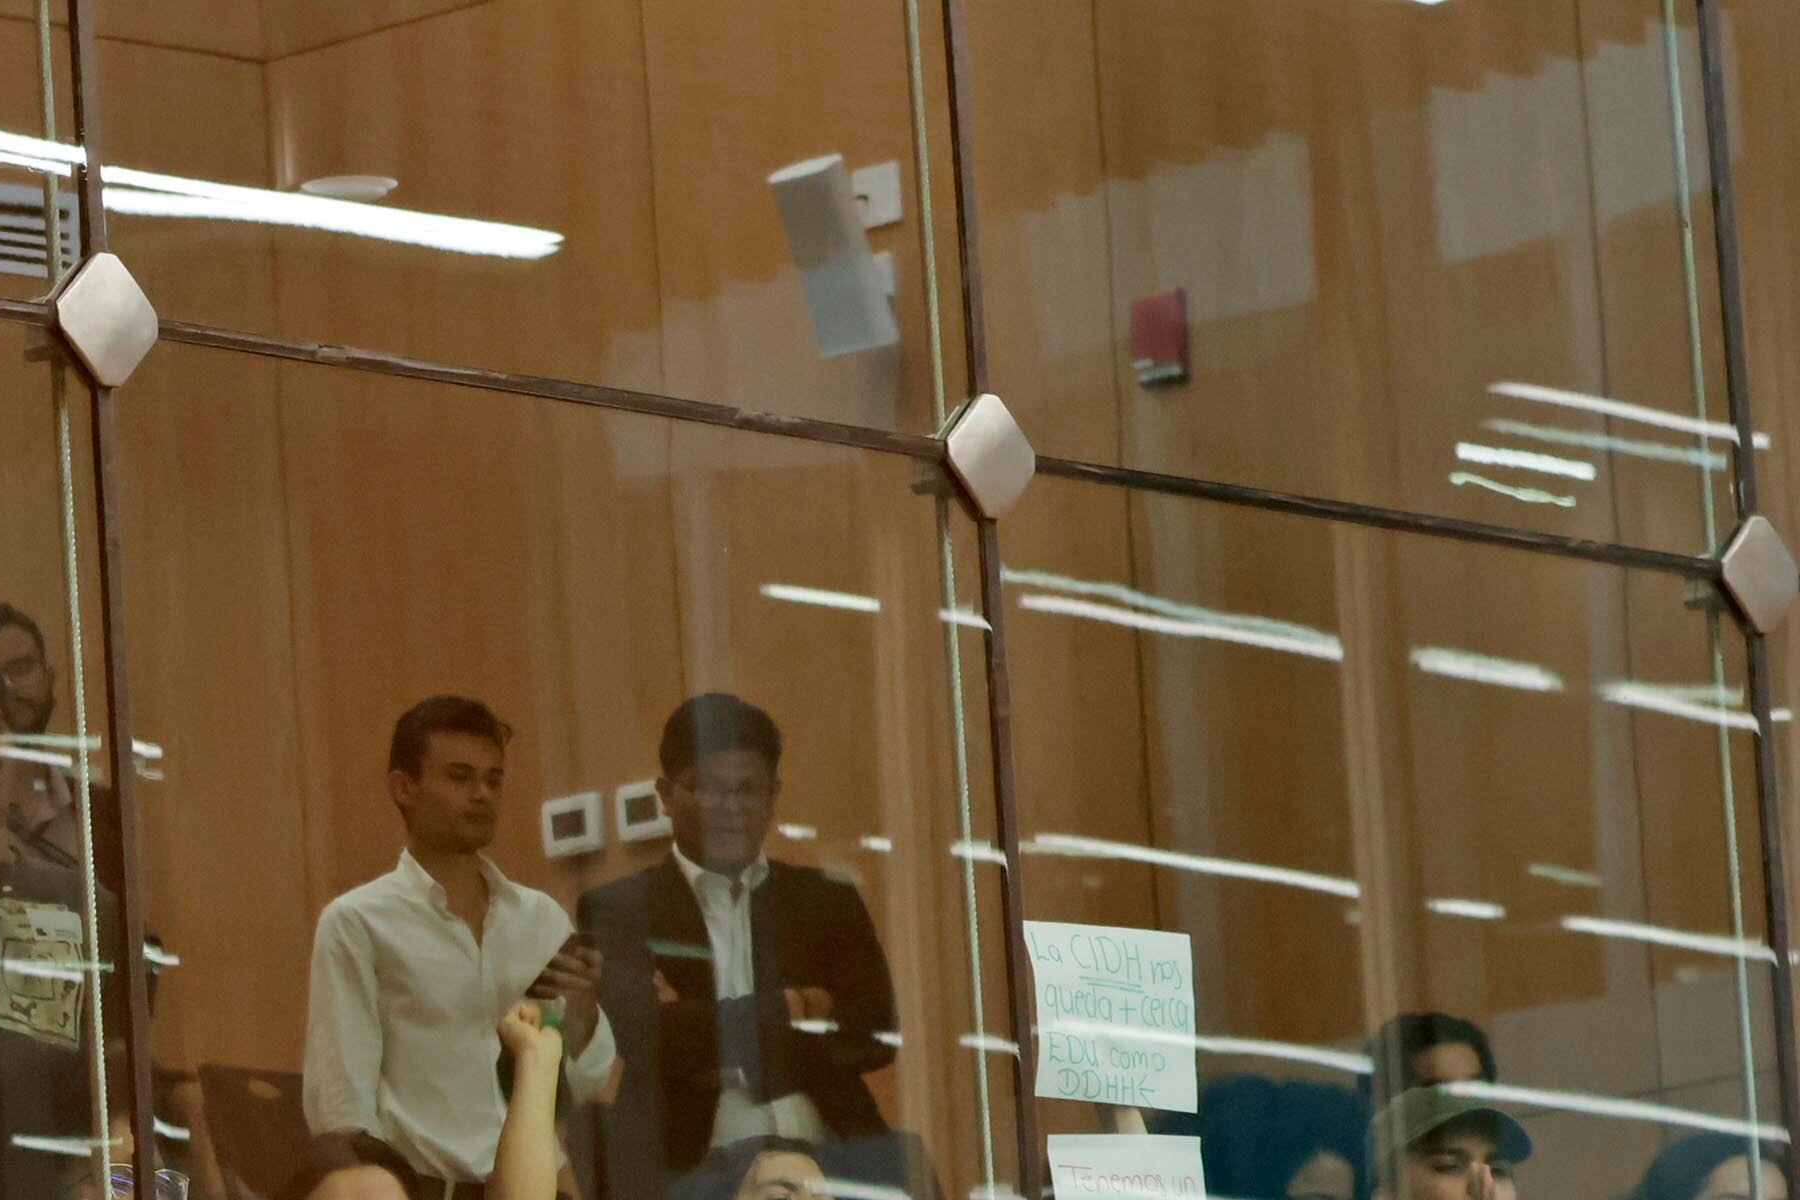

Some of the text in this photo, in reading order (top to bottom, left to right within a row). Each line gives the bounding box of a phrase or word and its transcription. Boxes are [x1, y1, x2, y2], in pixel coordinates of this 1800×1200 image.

[1029, 931, 1183, 991] La CIDH nos
[1044, 983, 1114, 1024] queda
[1140, 995, 1190, 1034] cerca
[1109, 1045, 1167, 1073] como
[1057, 1164, 1198, 1198] Tenemos un
